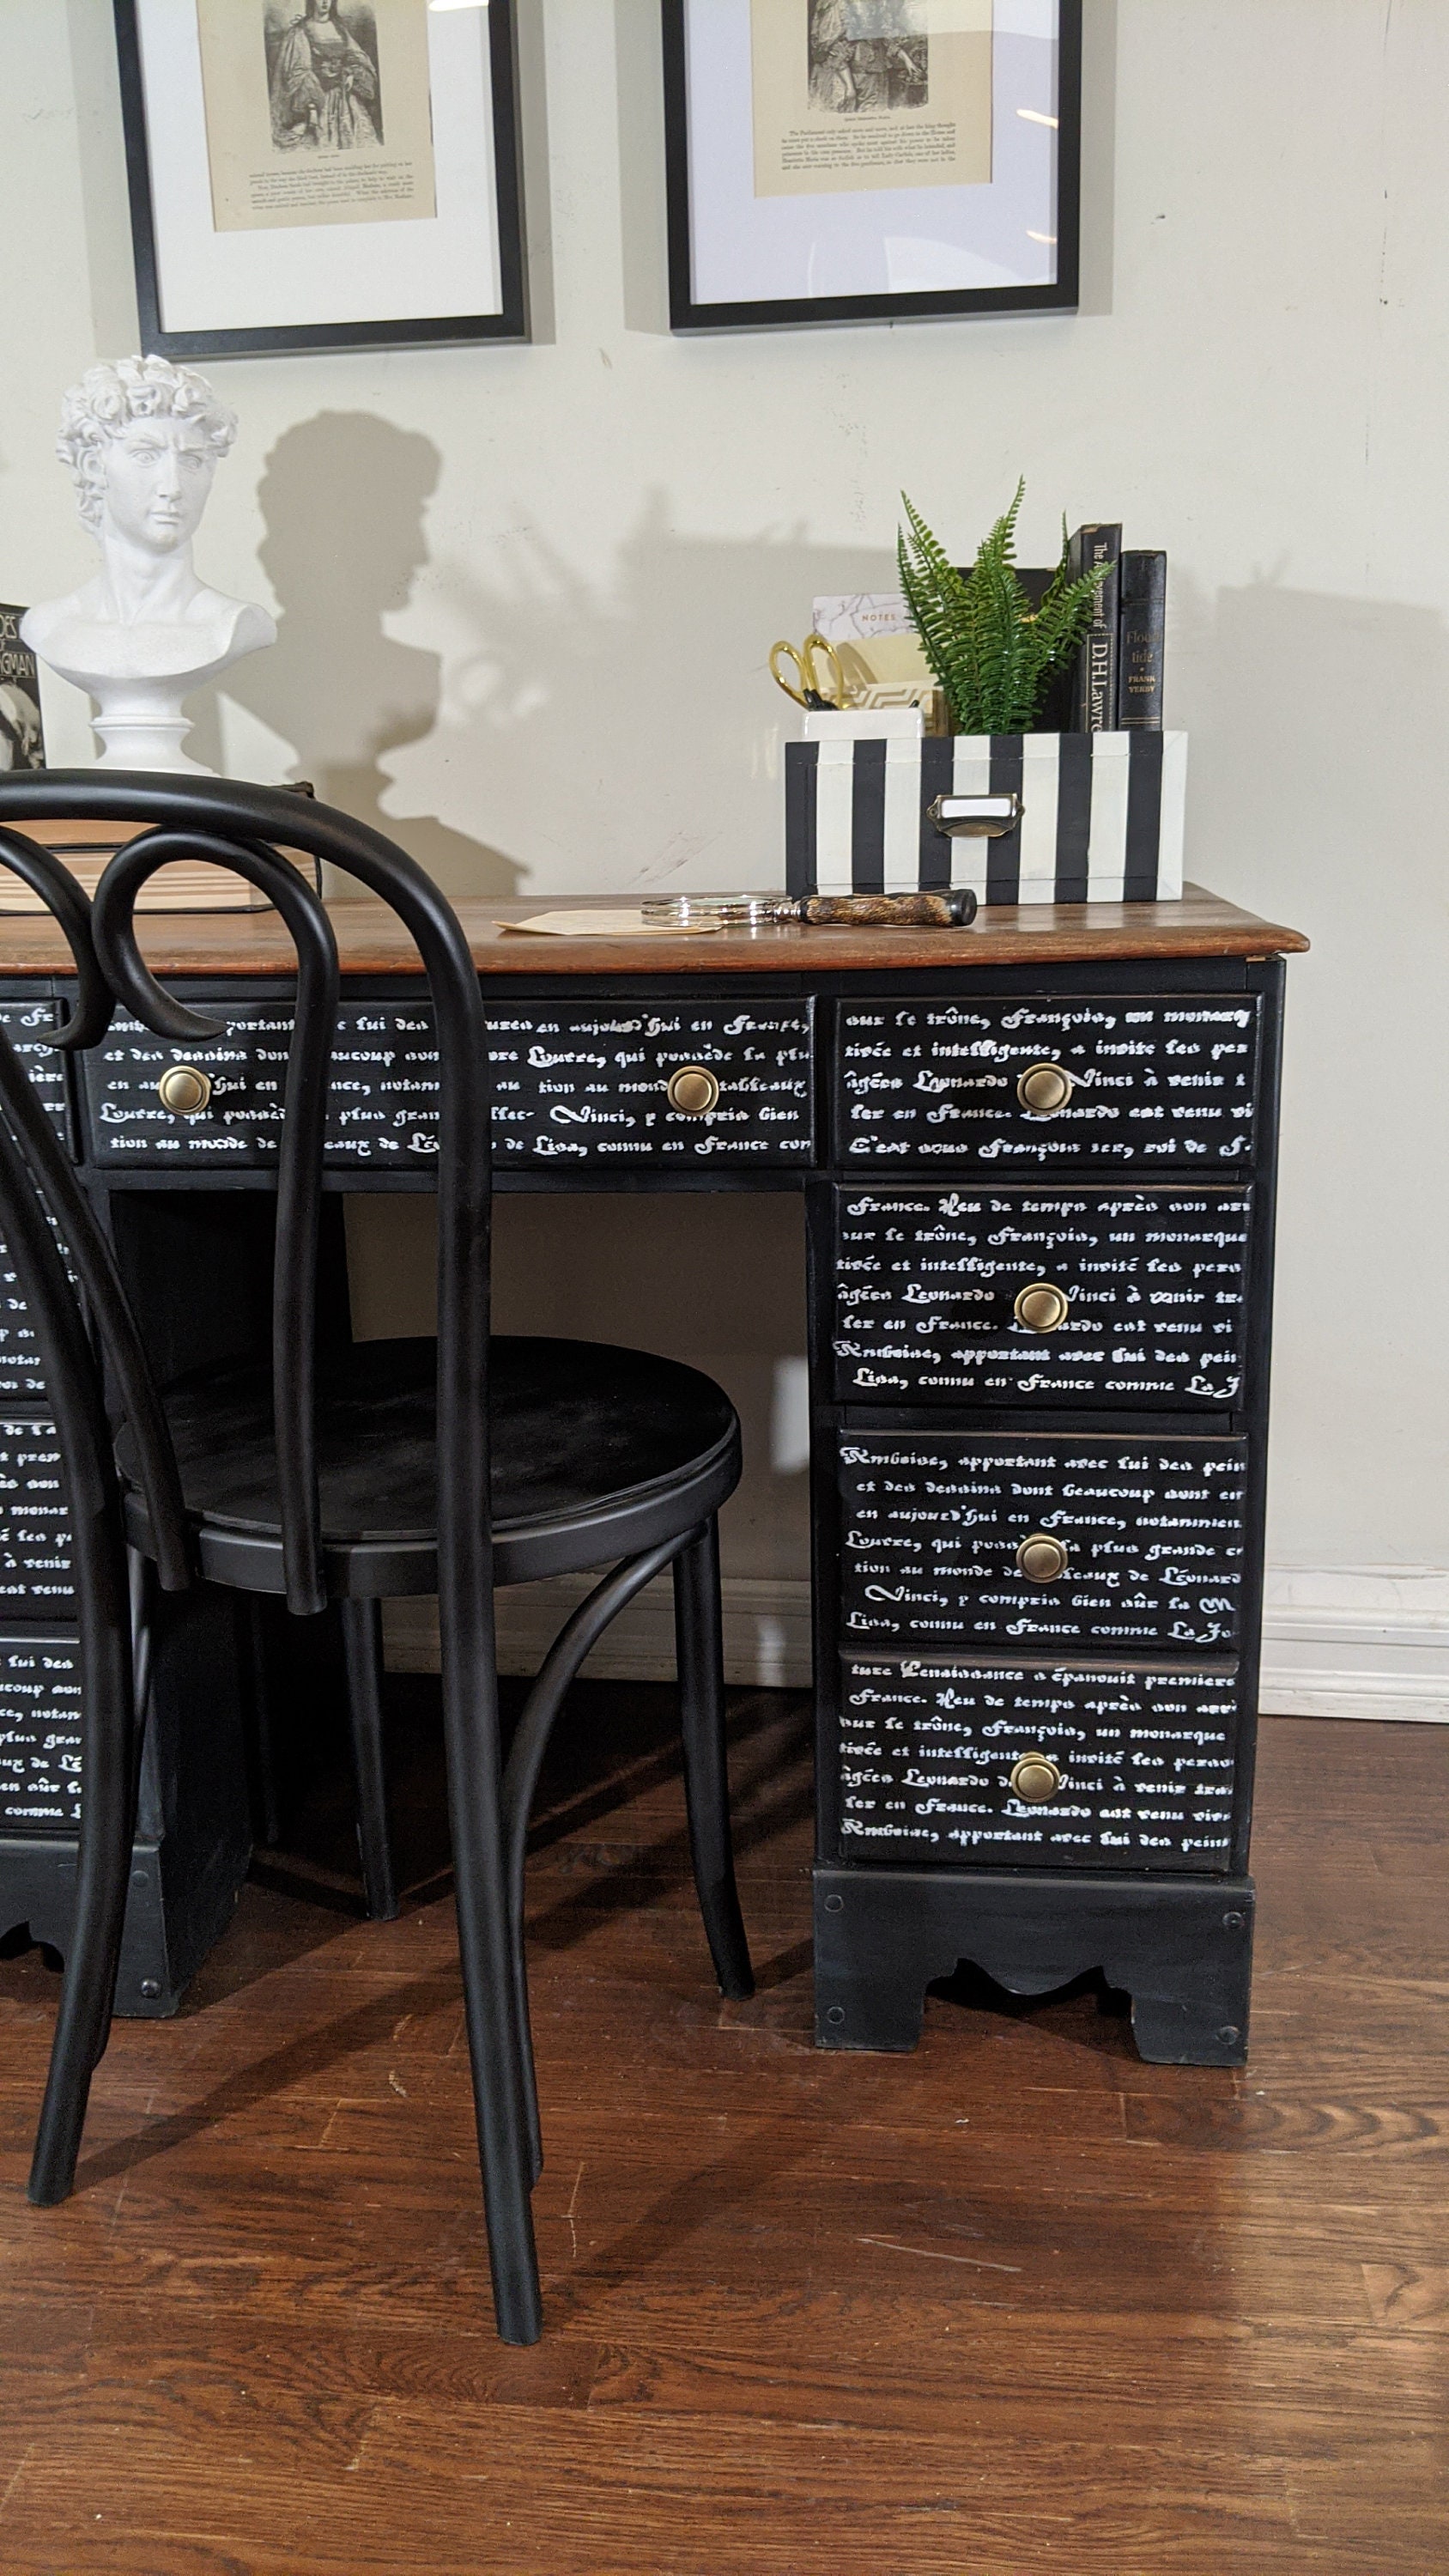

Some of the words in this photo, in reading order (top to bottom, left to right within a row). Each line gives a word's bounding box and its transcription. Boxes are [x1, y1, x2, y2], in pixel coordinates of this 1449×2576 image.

[1094, 542, 1108, 560] The
[861, 613, 896, 623] NOTES
[1093, 619, 1106, 629] of
[1127, 675, 1156, 683] FRANK
